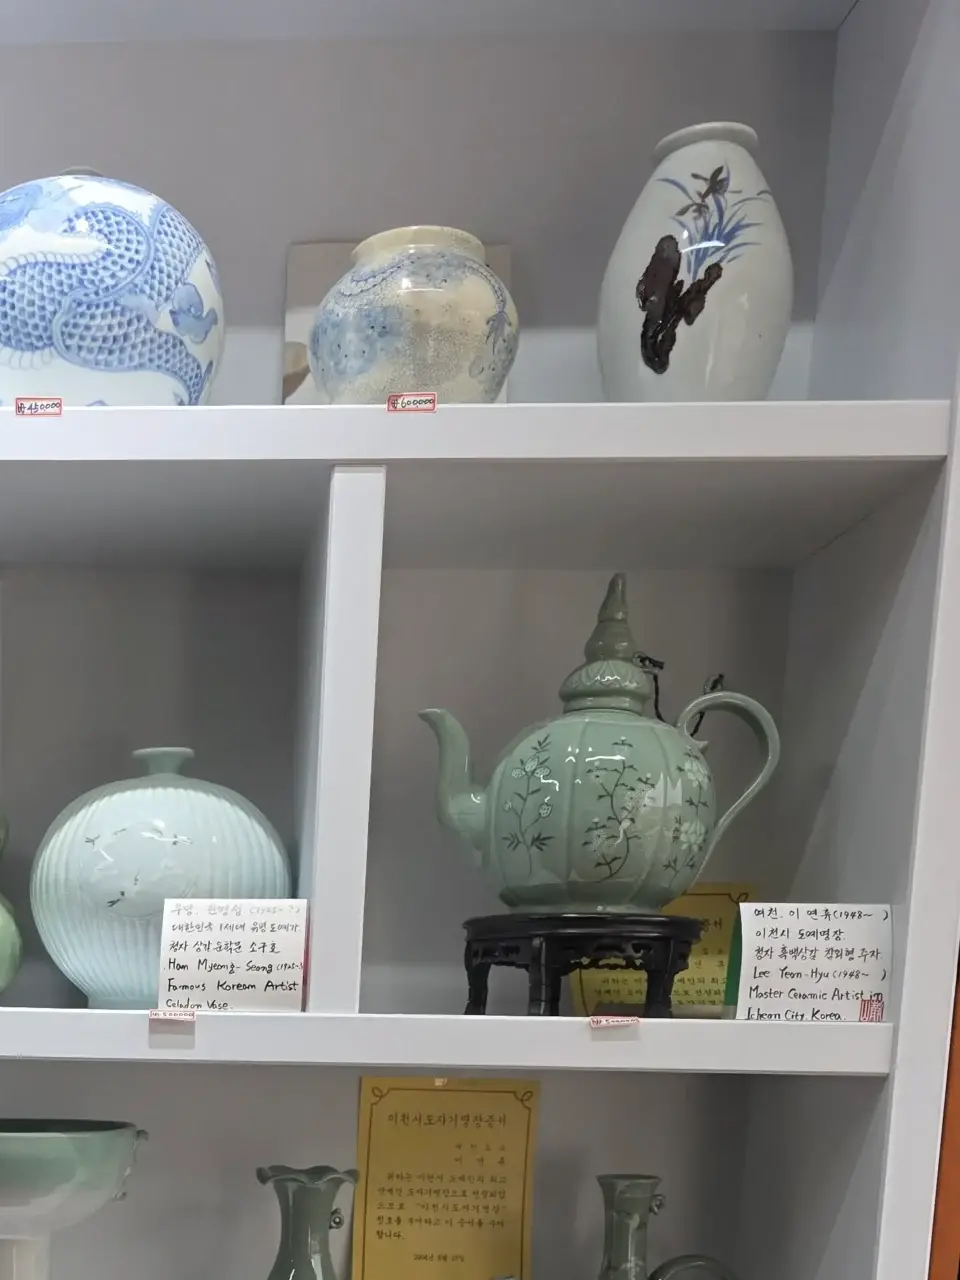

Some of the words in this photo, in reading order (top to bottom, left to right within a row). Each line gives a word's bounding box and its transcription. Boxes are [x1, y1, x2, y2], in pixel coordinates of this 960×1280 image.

[172, 922, 213, 932] 대한민국
[756, 929, 790, 939] 이천시
[753, 966, 770, 979] Lee
[167, 977, 206, 992] Famous
[217, 980, 256, 991] Korean
[264, 980, 299, 992] Artist
[749, 986, 784, 999] Master
[788, 988, 827, 1000] Ceramic
[832, 988, 864, 1001] Artist
[166, 998, 202, 1009] Celadon
